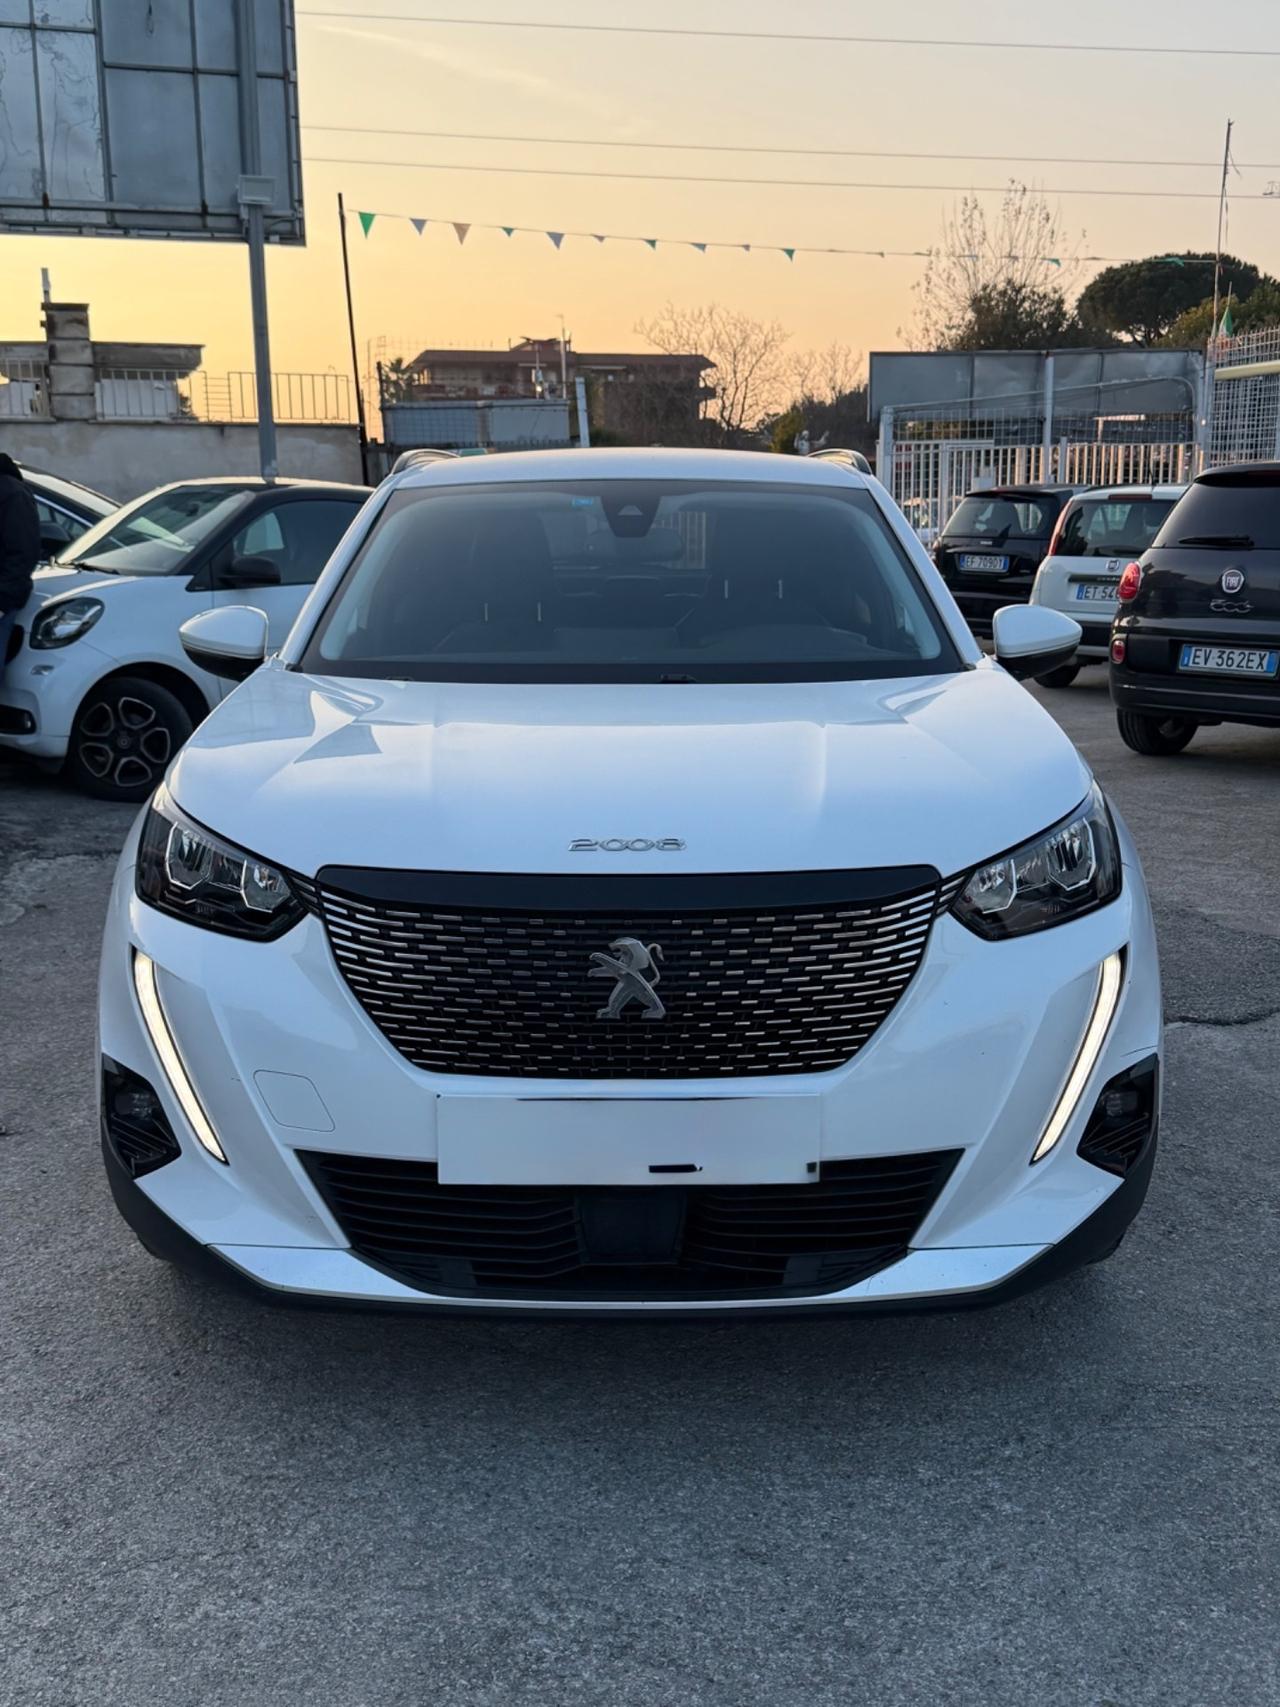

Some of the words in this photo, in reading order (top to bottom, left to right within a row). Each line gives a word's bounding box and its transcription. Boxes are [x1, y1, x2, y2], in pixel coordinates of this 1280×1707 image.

[1084, 586, 1098, 599] ET
[1192, 648, 1212, 666] EV
[1216, 649, 1267, 670] 362EX
[568, 838, 687, 851] 2008
